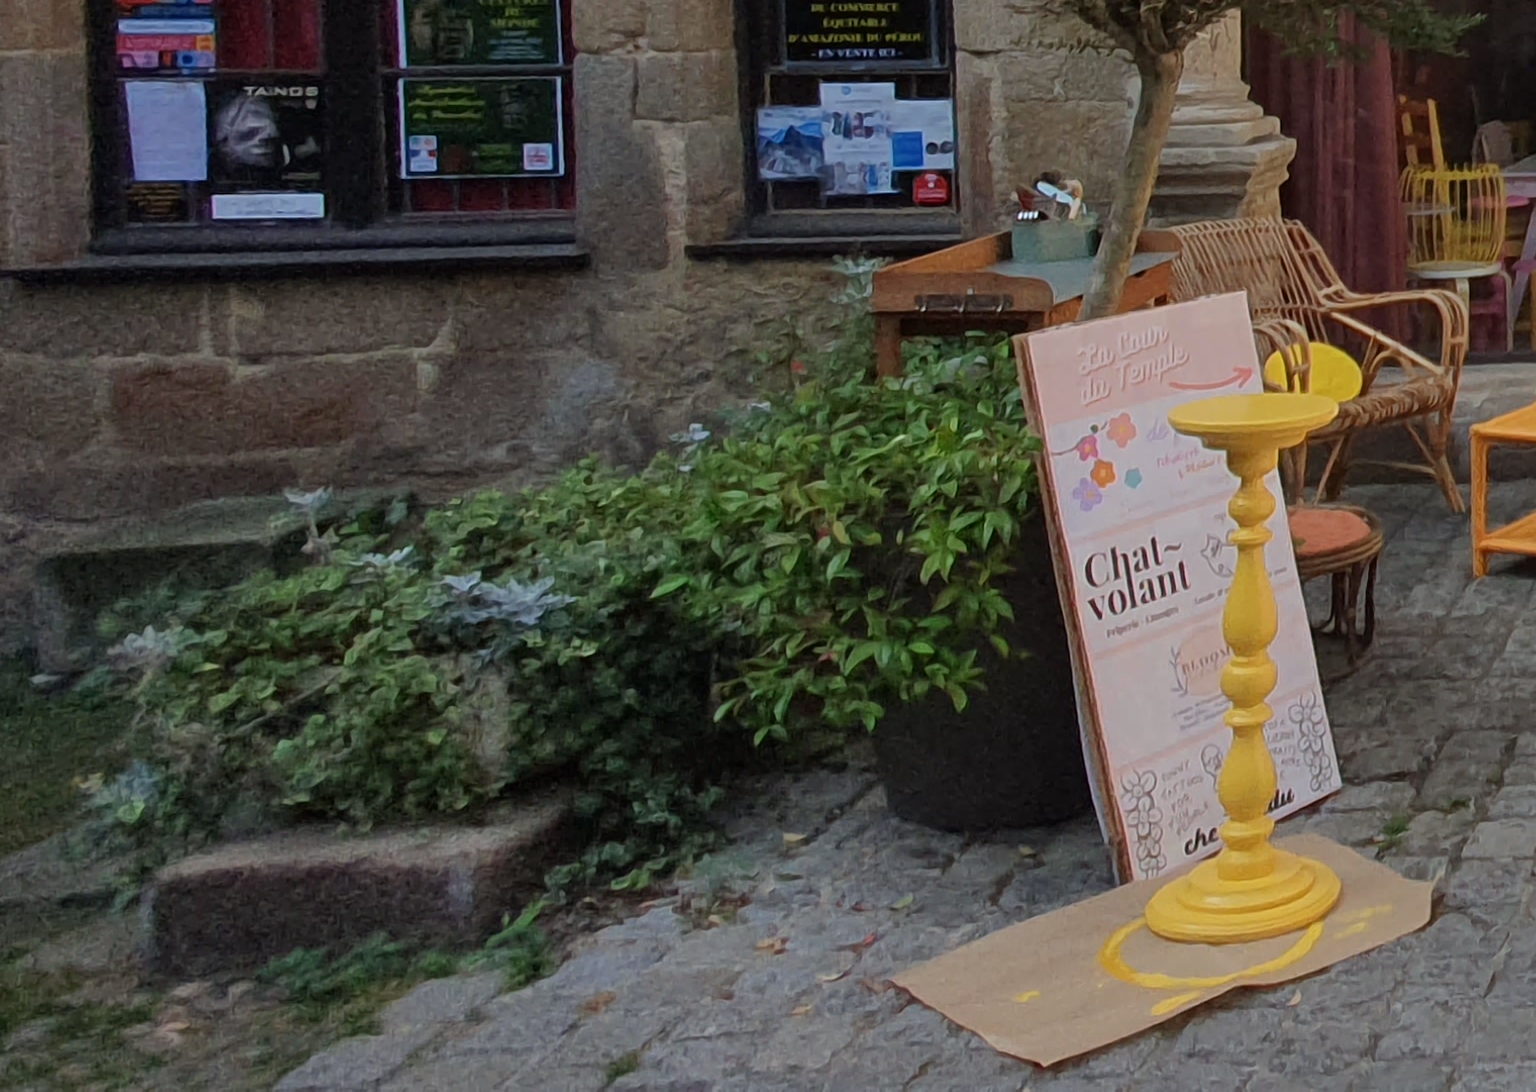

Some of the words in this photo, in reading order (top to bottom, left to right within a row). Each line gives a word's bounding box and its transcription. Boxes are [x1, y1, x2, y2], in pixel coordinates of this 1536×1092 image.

[1077, 343, 1115, 377] La
[1117, 326, 1169, 359] Cour
[1081, 378, 1111, 408] du
[1116, 343, 1189, 394] Temple
[1087, 561, 1191, 621] volant
